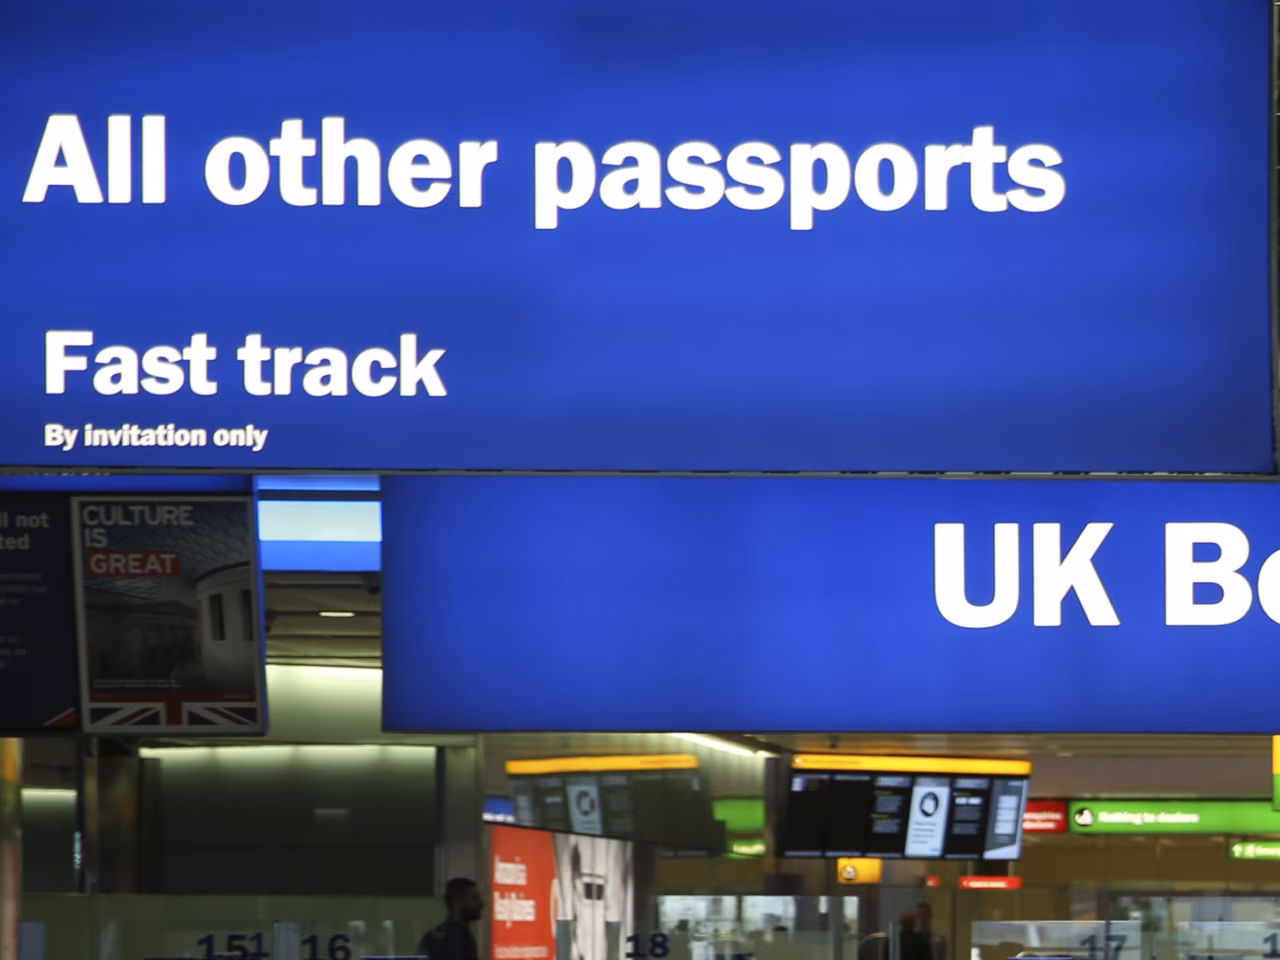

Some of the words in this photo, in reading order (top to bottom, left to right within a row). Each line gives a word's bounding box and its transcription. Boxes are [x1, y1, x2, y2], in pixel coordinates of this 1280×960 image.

[22, 115, 165, 204] All
[205, 117, 498, 208] other
[535, 126, 1065, 230] passports
[45, 331, 217, 396] Fast
[237, 333, 447, 397] track
[44, 424, 79, 451] By
[84, 424, 207, 447] invitation
[213, 424, 269, 452] only
[16, 512, 50, 528] not
[83, 505, 194, 525] CULTURE
[84, 527, 107, 548] IS
[90, 553, 177, 574] GREAT
[934, 522, 1121, 629] UK
[626, 933, 670, 959] 18
